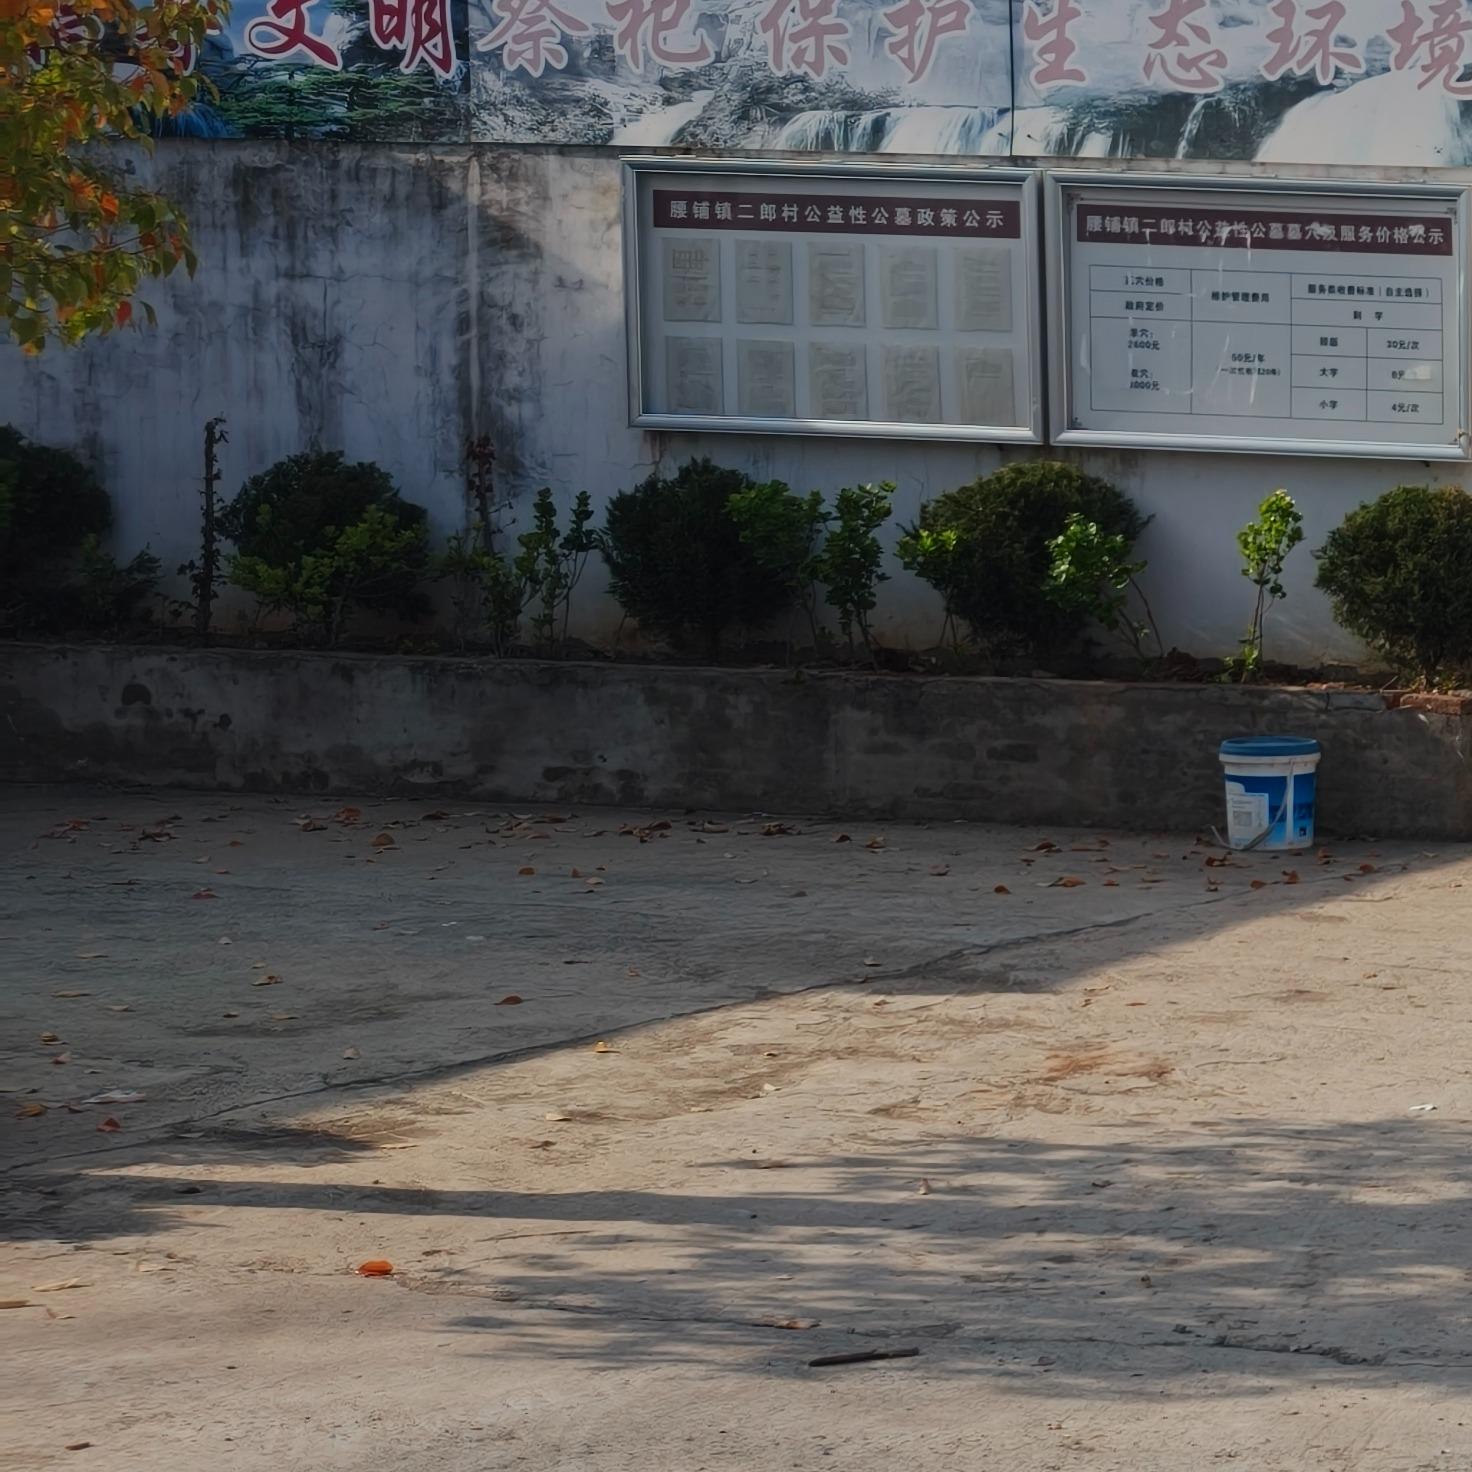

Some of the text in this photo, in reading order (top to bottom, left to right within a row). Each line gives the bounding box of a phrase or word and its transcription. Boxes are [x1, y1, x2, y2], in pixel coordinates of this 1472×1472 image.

[669, 200, 1005, 229] 腰铺镇二郎村公益性公墓政策公示
